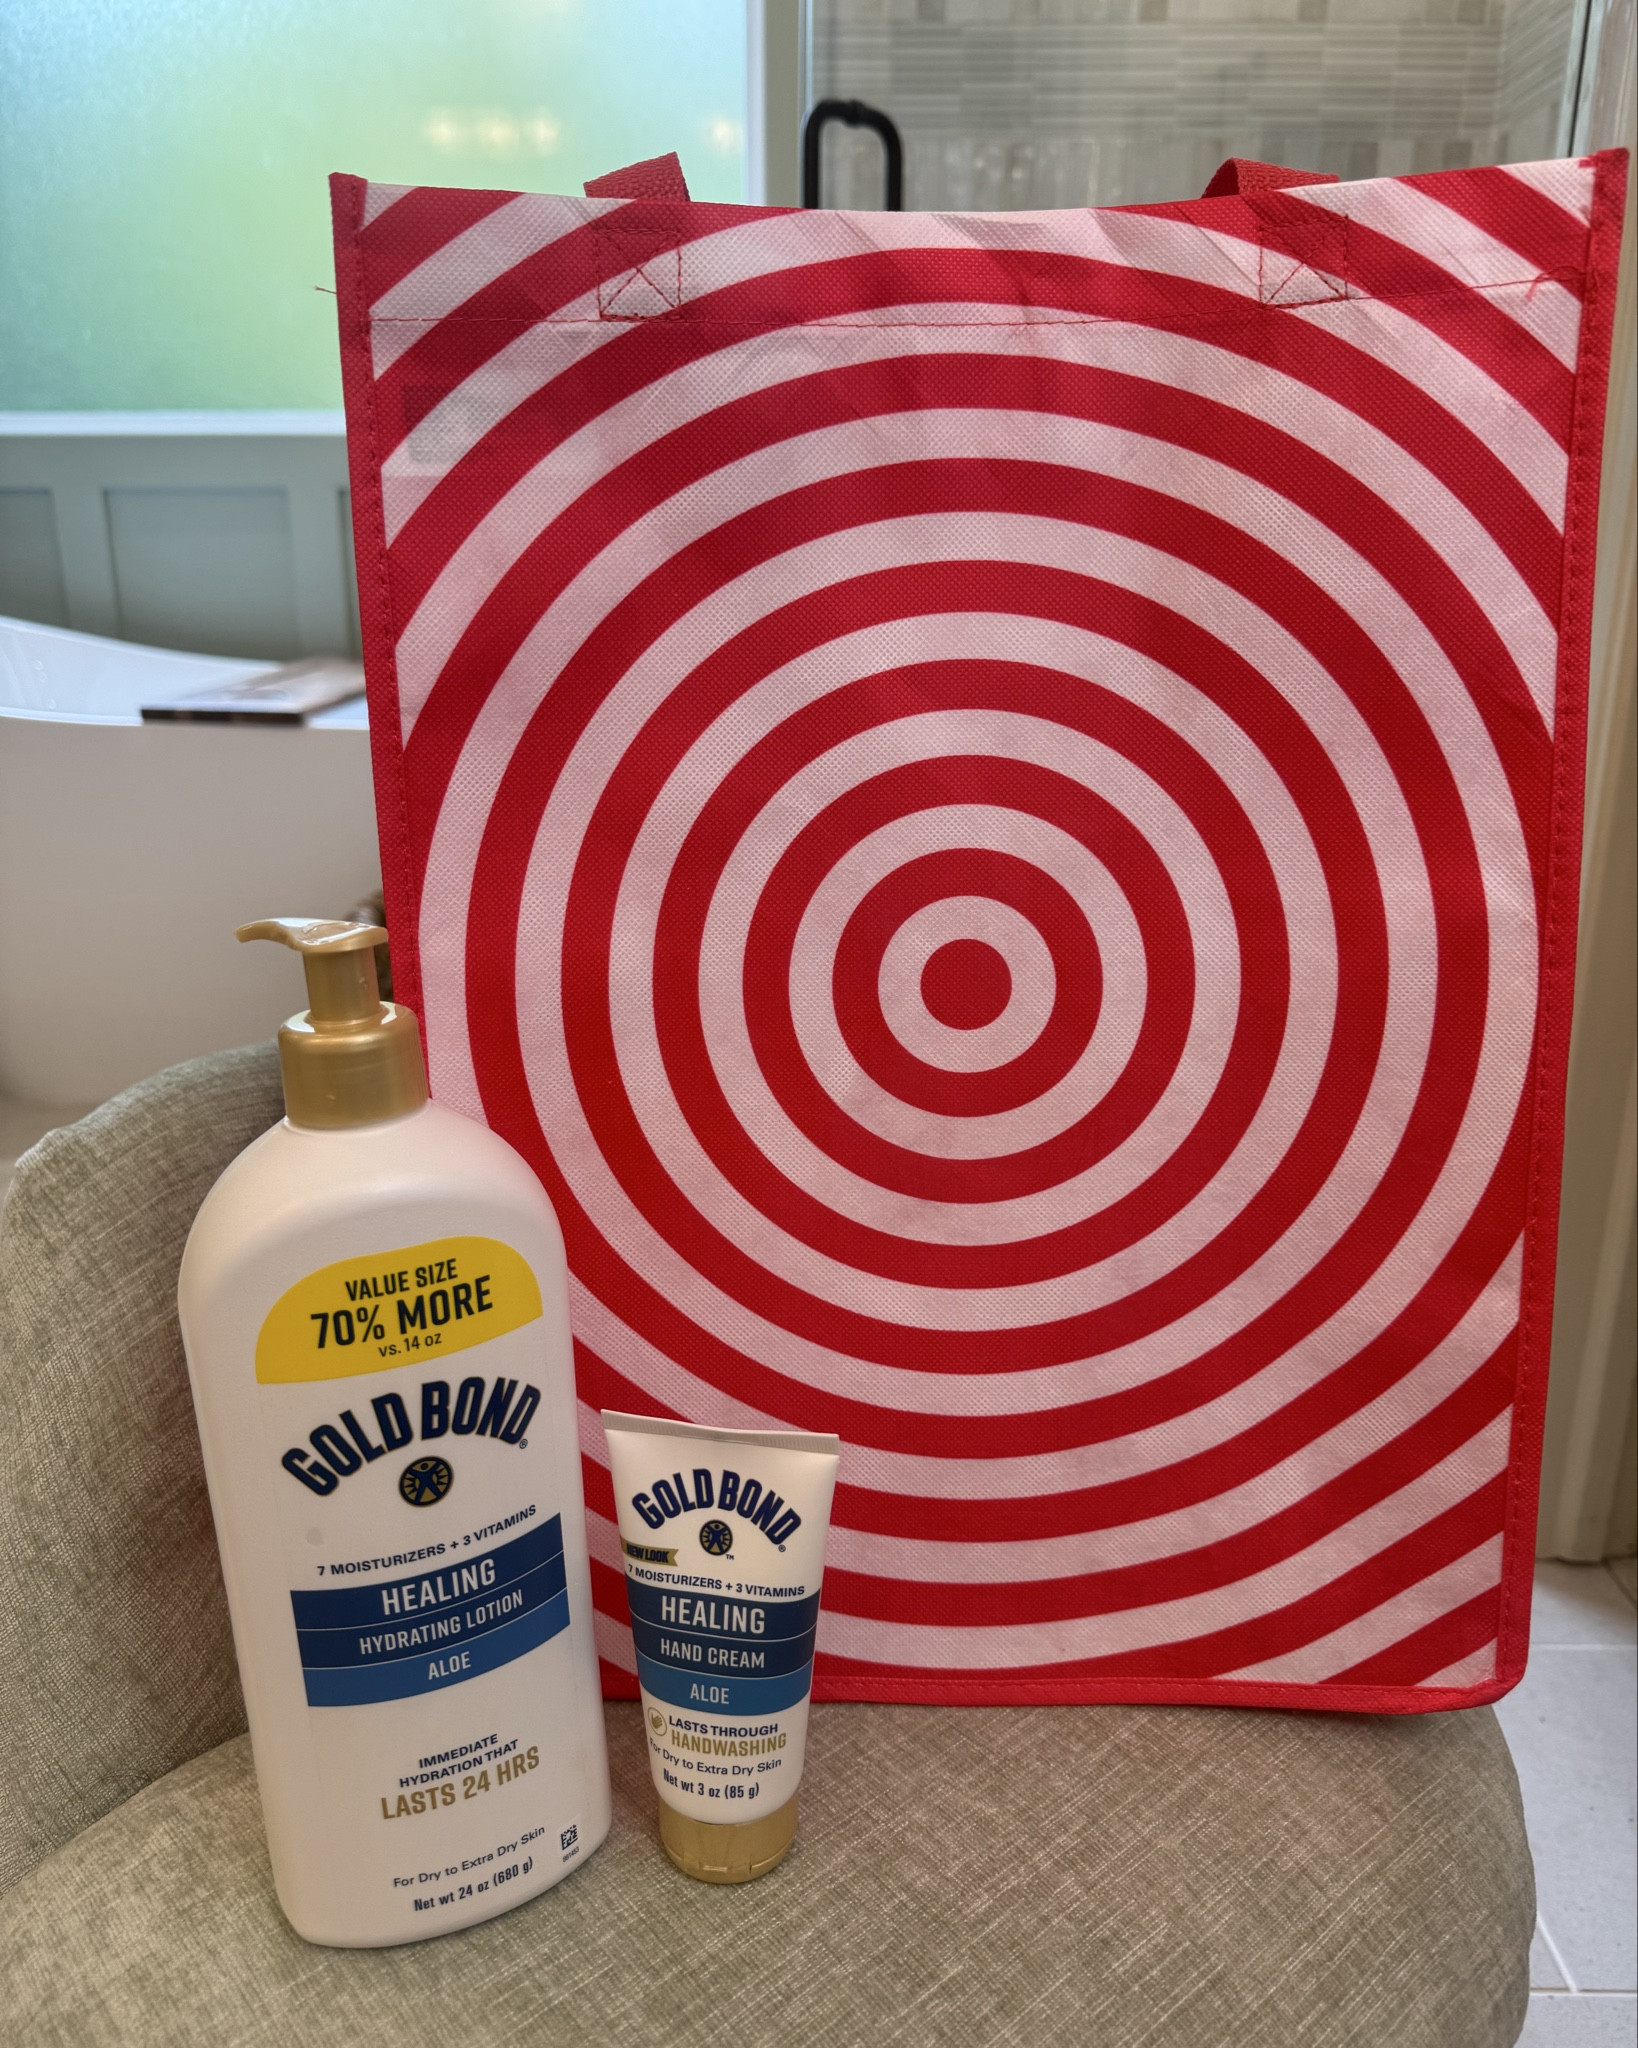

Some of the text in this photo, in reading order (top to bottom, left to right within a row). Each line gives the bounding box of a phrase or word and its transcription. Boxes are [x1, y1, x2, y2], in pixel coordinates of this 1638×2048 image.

[345, 1258, 458, 1301] VALUE SIZE
[310, 1274, 493, 1349] 70% MORE
[378, 1333, 443, 1357] vs. 14 oz
[281, 1392, 414, 1497] GOLD
[631, 1468, 714, 1529] GOLD
[317, 1504, 537, 1576] 7 MOISTURIZERS + 3 VITAMINS
[626, 1543, 669, 1563] NEW LOOK
[381, 1558, 496, 1615] HEALING
[628, 1563, 805, 1598] 7 MOISTURIZERS + 3 VITAMINS
[359, 1589, 523, 1655] HYDRATING LOTION
[661, 1595, 765, 1634] HEALING
[428, 1651, 471, 1680] ALOE
[660, 1638, 765, 1669] HAND CREAM
[690, 1683, 730, 1705] ALOE
[669, 1715, 778, 1737] LASTS THROUGH
[671, 1730, 787, 1757] HANDWASHING
[399, 1739, 518, 1788] HYDRATION THAT
[419, 1734, 499, 1769] IMMEDIATE
[650, 1736, 782, 1776] For Dry to Extra Dry Skin
[381, 1745, 540, 1819] LASTS 24 HRS
[663, 1768, 760, 1799] Net wt 3 oz (85 g)
[393, 1825, 545, 1888] For Dry to Extra Dry Skin
[414, 1856, 533, 1911] Net wt 24 oz (680 g)
